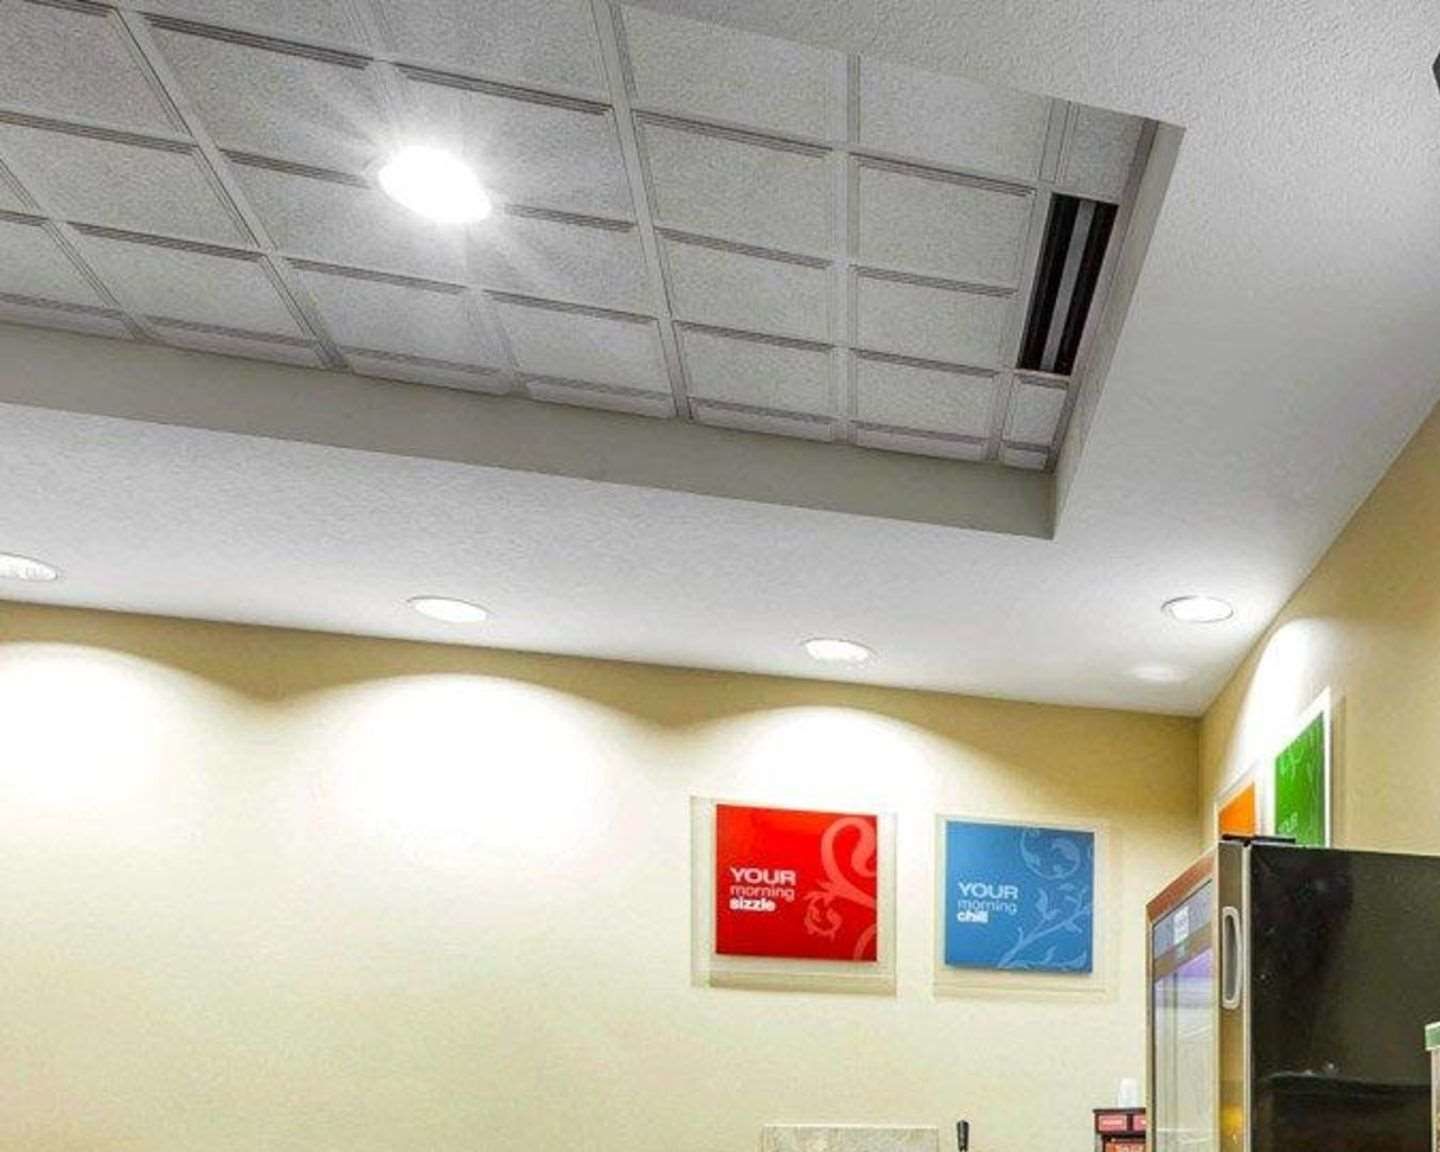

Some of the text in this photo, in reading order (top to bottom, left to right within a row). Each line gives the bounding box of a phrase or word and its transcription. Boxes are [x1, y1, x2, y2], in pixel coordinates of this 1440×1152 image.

[729, 867, 796, 886] YOUR
[729, 885, 796, 902] morning
[957, 881, 1018, 899] YOUR
[729, 897, 776, 912] sizzle
[957, 899, 1018, 915] morning
[956, 909, 988, 923] chill
